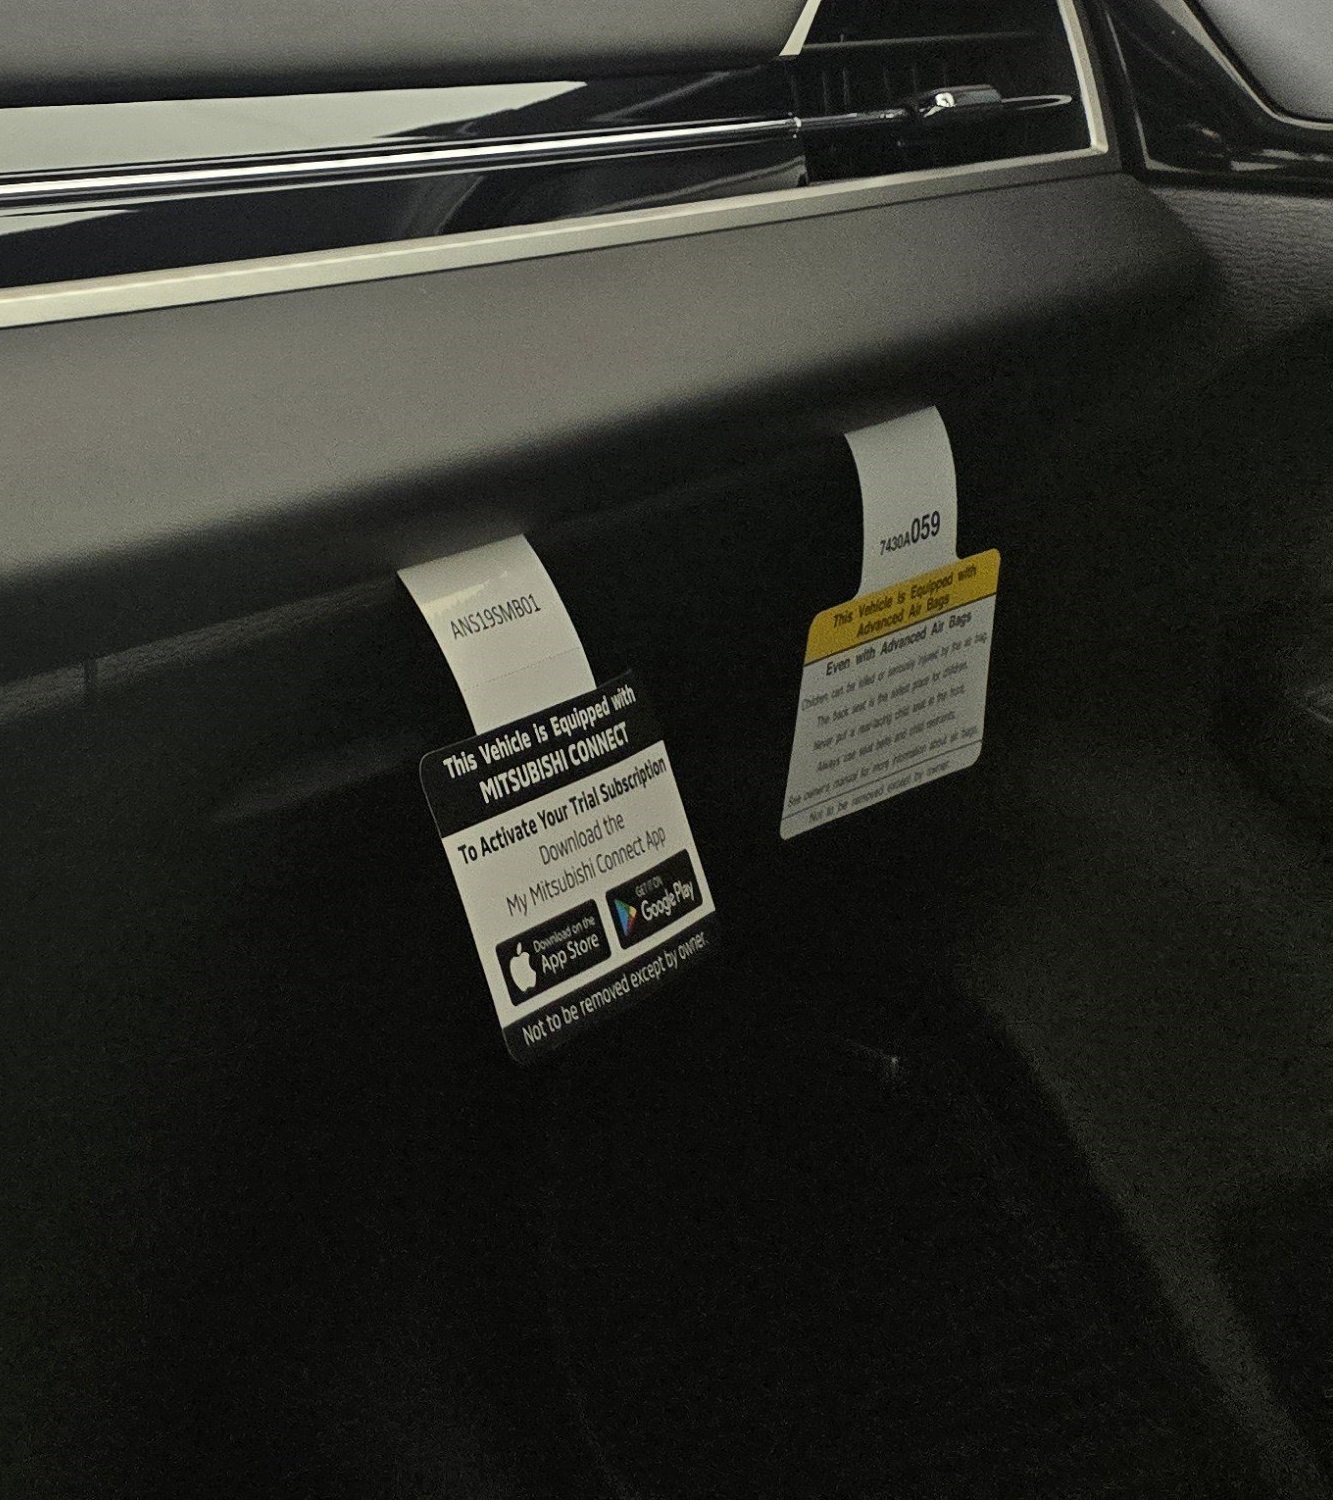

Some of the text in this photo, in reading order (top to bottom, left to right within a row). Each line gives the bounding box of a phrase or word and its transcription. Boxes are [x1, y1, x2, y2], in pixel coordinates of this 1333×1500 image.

[879, 509, 941, 556] 7430A059
[450, 593, 542, 640] ANS19SMB01
[442, 684, 636, 778] This Vehicle is Equipped with
[479, 721, 628, 803] MITSUBISHI CONNECT
[457, 757, 666, 864] To Activate Your Trial Subscription
[538, 813, 625, 865] Download the
[505, 826, 665, 916] My Mitsubishi Connect App
[640, 880, 694, 921] Google Play
[532, 916, 595, 952] Download on the
[541, 933, 599, 973] App Store
[521, 1019, 547, 1045] Not
[545, 1013, 561, 1032] to
[560, 1004, 579, 1024] be
[579, 973, 630, 1015] removed
[630, 955, 666, 987] except
[663, 949, 677, 968] by
